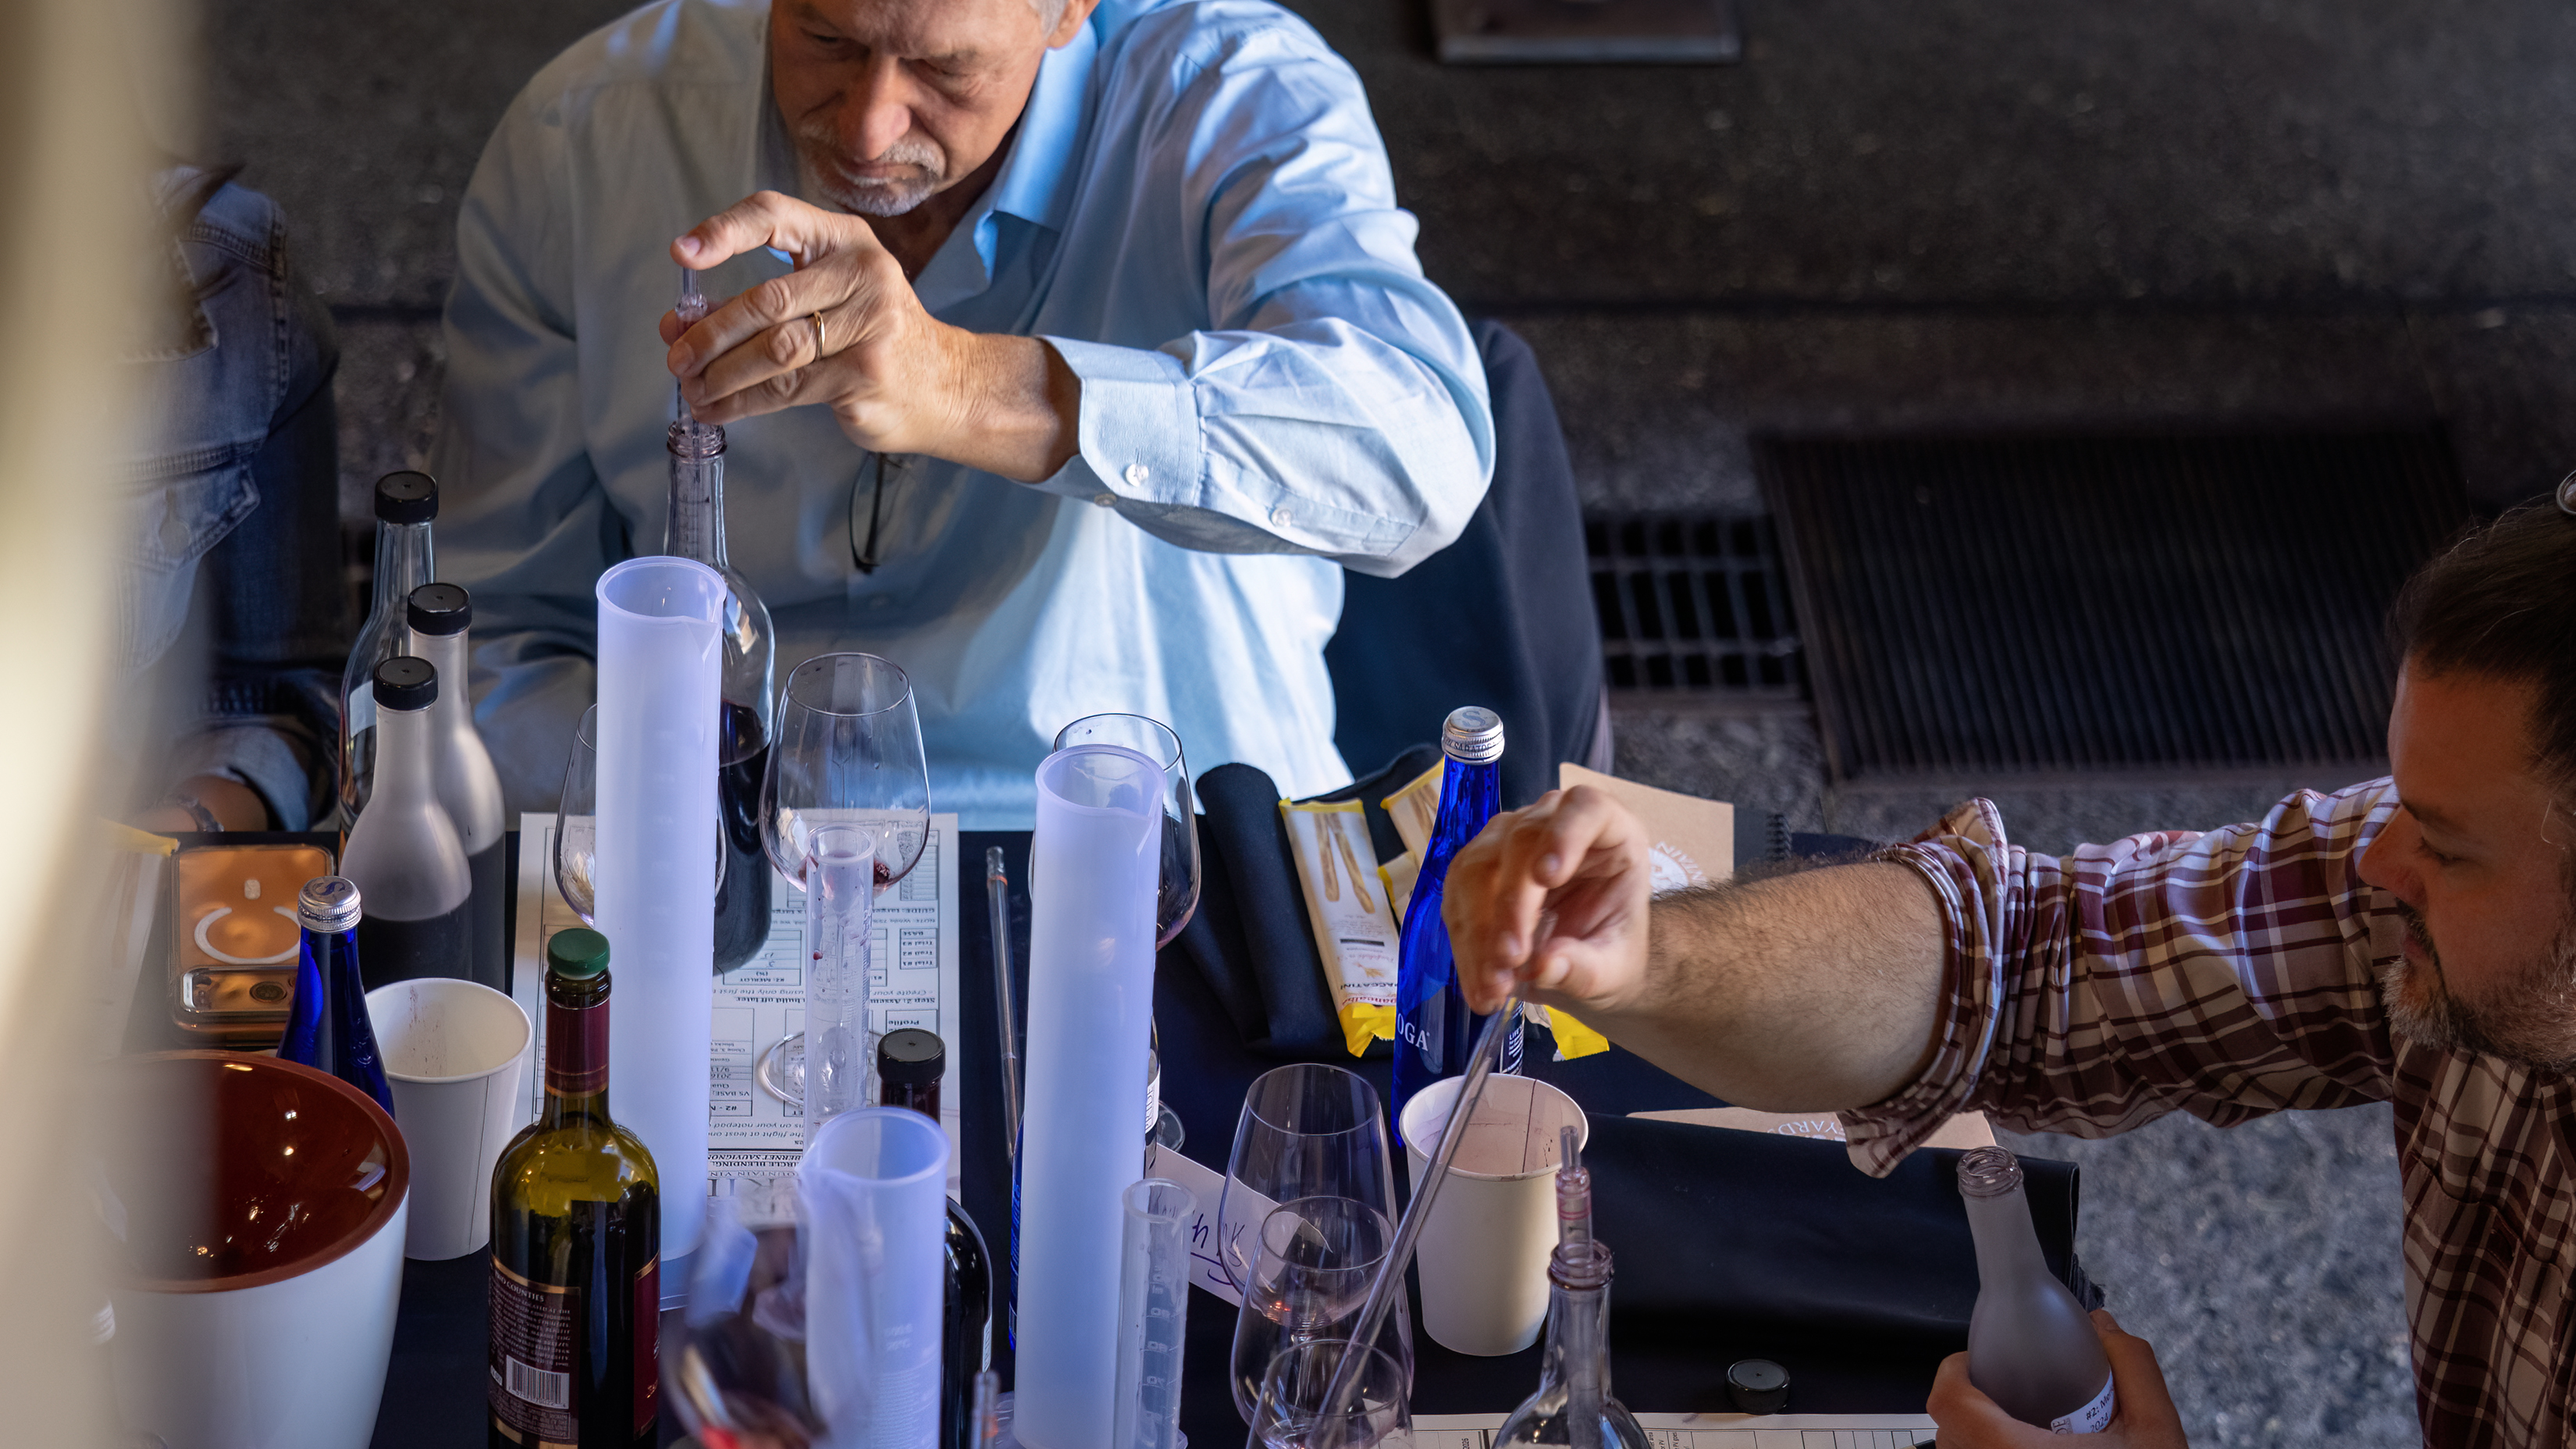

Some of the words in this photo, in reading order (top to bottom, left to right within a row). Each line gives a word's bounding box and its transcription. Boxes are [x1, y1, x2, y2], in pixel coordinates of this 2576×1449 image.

[1397, 1013, 1429, 1052] OGA
[763, 1129, 787, 1137] flight
[2086, 1405, 2100, 1421] #2:
